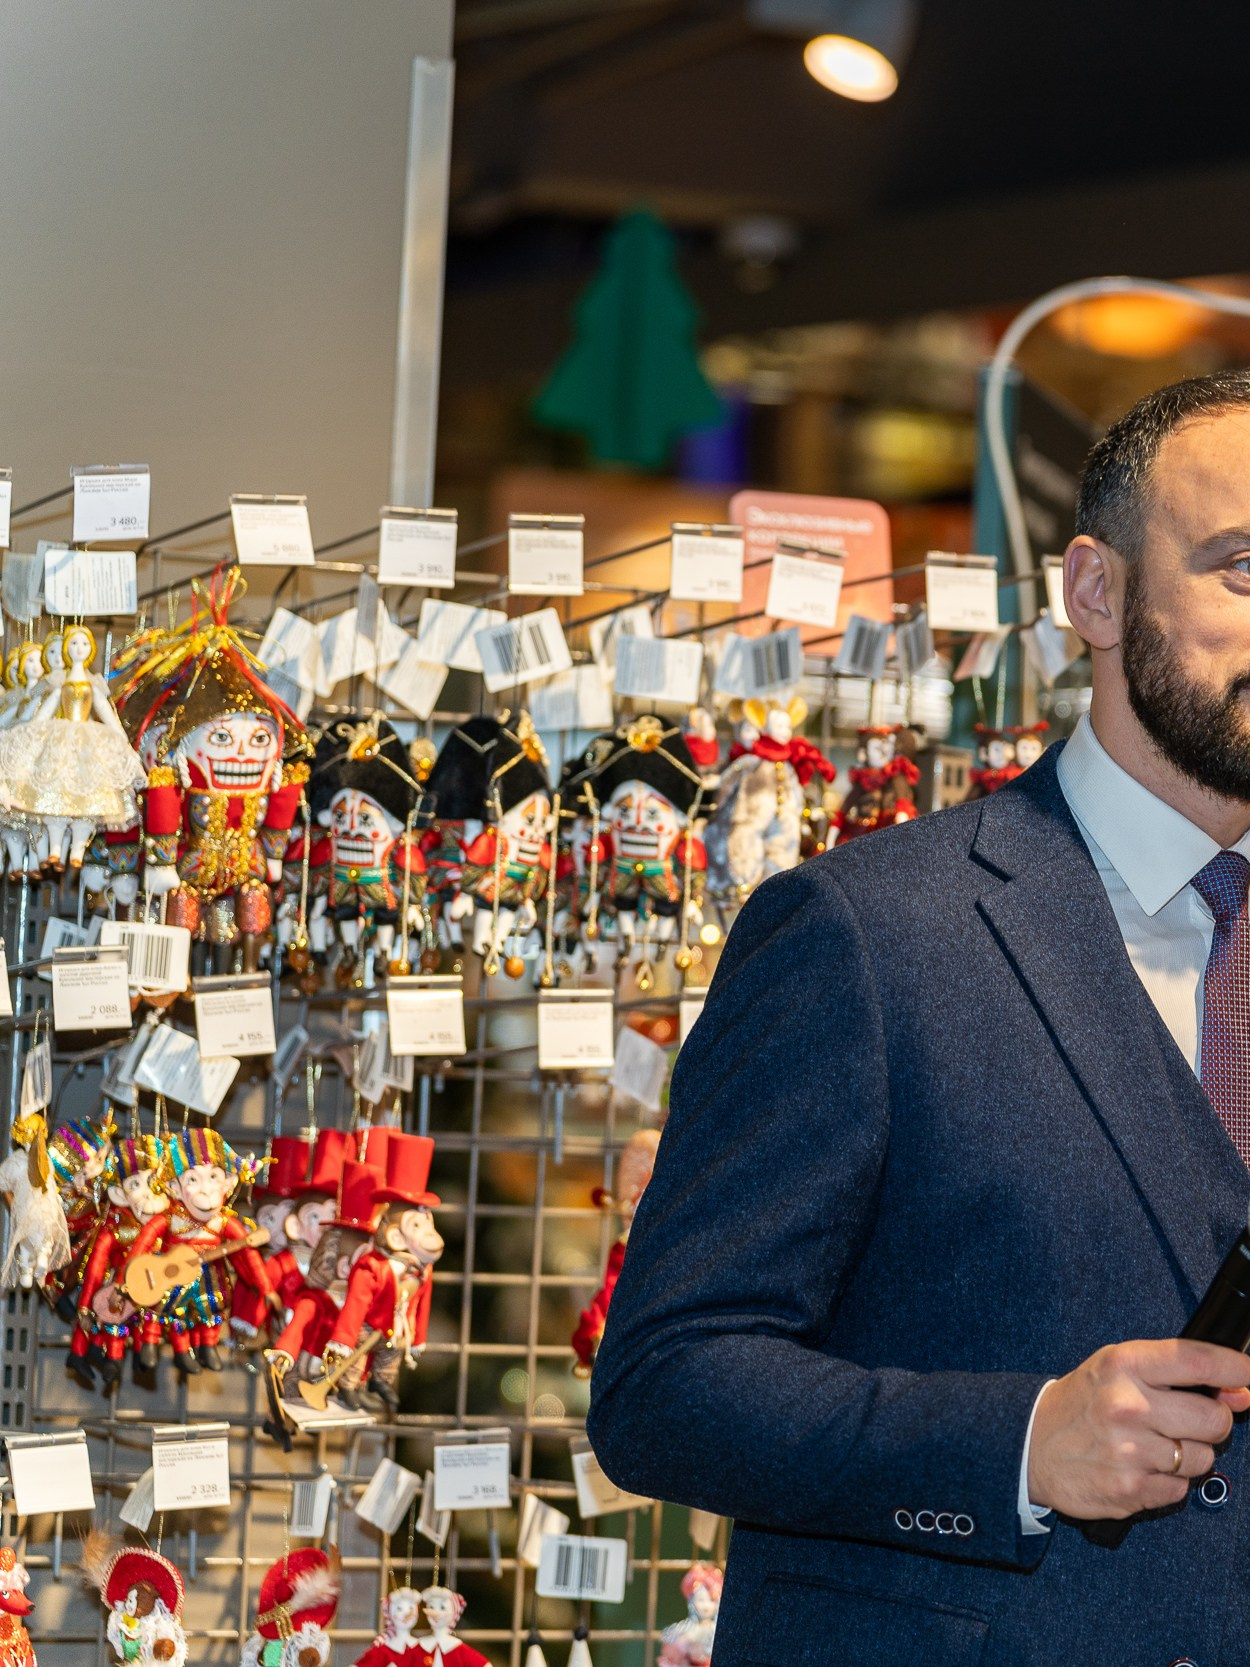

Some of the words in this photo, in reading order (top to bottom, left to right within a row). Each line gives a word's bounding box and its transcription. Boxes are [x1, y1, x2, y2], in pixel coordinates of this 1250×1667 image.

[110, 516, 117, 527] 3
[119, 516, 137, 526] 480
[91, 1005, 97, 1015] 2
[99, 1004, 118, 1015] 088
[191, 1485, 197, 1495] 2
[199, 1483, 218, 1494] 328
